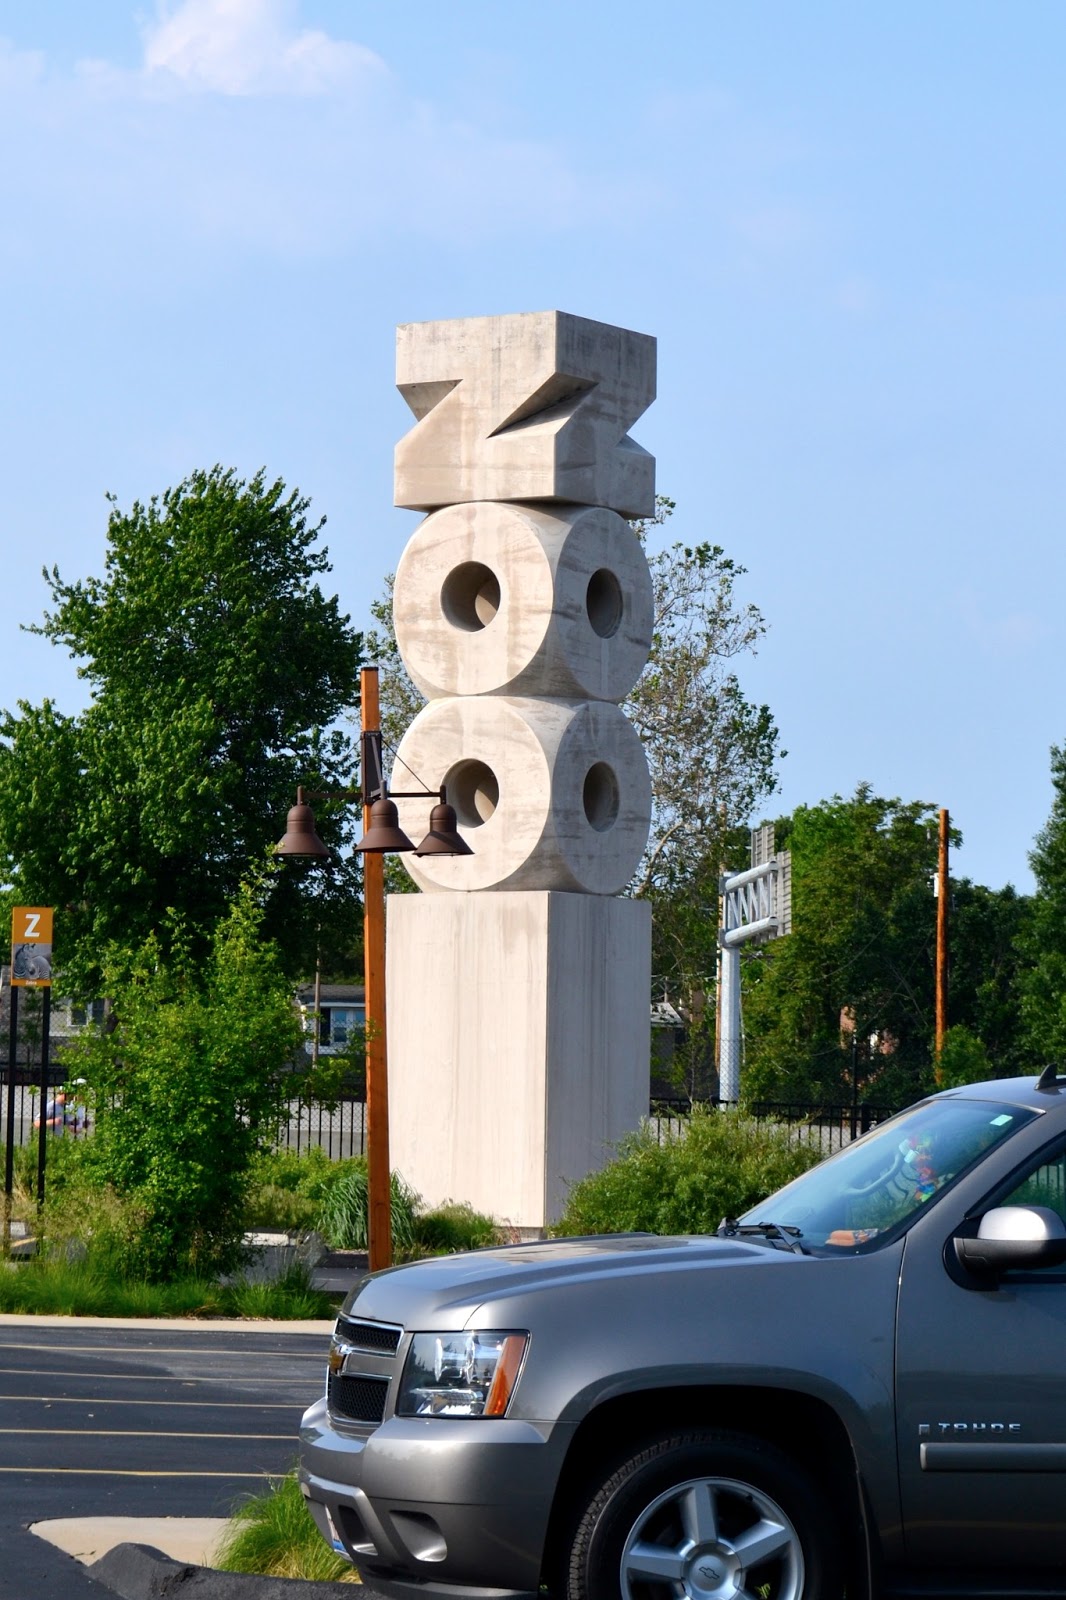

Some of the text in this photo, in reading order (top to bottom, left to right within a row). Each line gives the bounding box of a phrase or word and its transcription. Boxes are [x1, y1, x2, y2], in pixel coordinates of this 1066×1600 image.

[391, 311, 558, 892] ZOO
[24, 914, 41, 937] Z
[938, 1422, 1021, 1434] TAHOE
